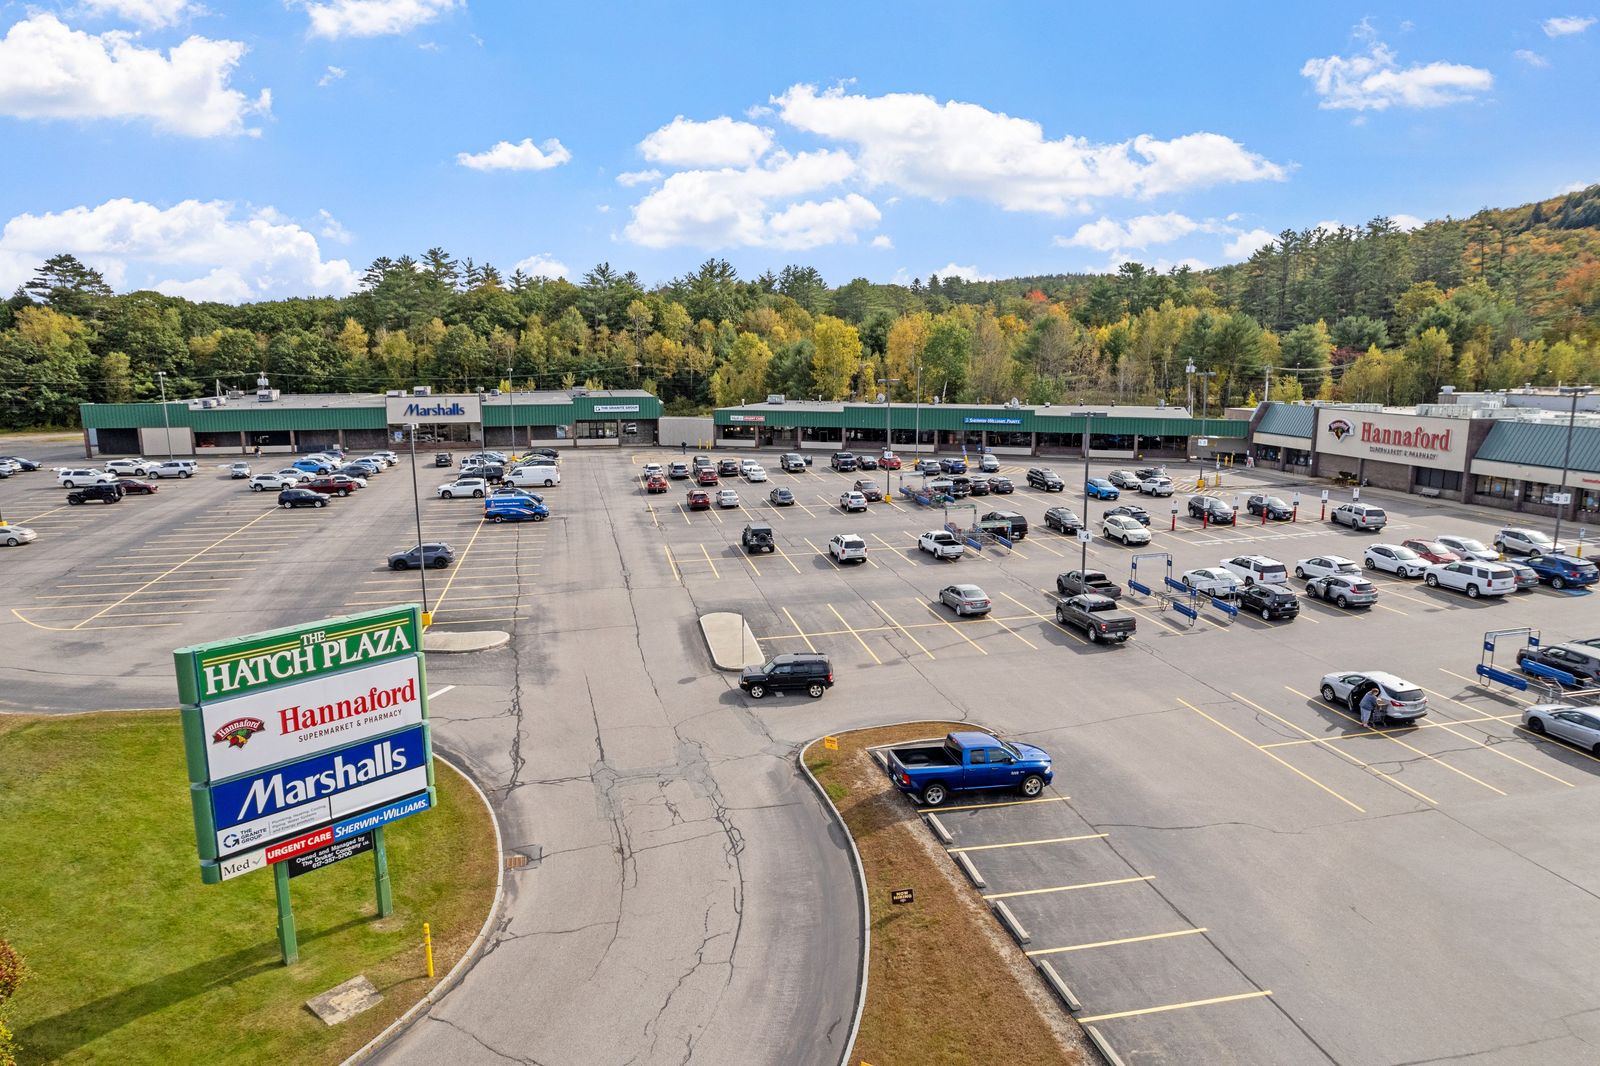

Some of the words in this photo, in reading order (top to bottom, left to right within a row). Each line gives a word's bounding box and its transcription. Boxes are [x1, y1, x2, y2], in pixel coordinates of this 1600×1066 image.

[403, 403, 465, 416] Marshalls
[1361, 422, 1451, 451] Hannaford
[301, 631, 326, 646] THE
[203, 645, 316, 695] HATCH
[321, 626, 411, 668] PLAZA
[277, 678, 416, 736] Hannaford
[217, 719, 260, 737] Hannaford
[299, 722, 353, 743] SUPERMARKET
[356, 719, 361, 727] &
[364, 709, 402, 724] PHARMACY
[237, 740, 407, 820] Marshalls
[240, 827, 267, 839] GRANITE
[241, 834, 262, 844] GROUP
[267, 840, 306, 859] URGENT
[307, 832, 332, 846] CARE
[296, 852, 316, 863] Owned
[319, 848, 329, 856] and
[331, 838, 356, 850] Managed
[335, 843, 361, 854] Company
[223, 859, 250, 876] Med
